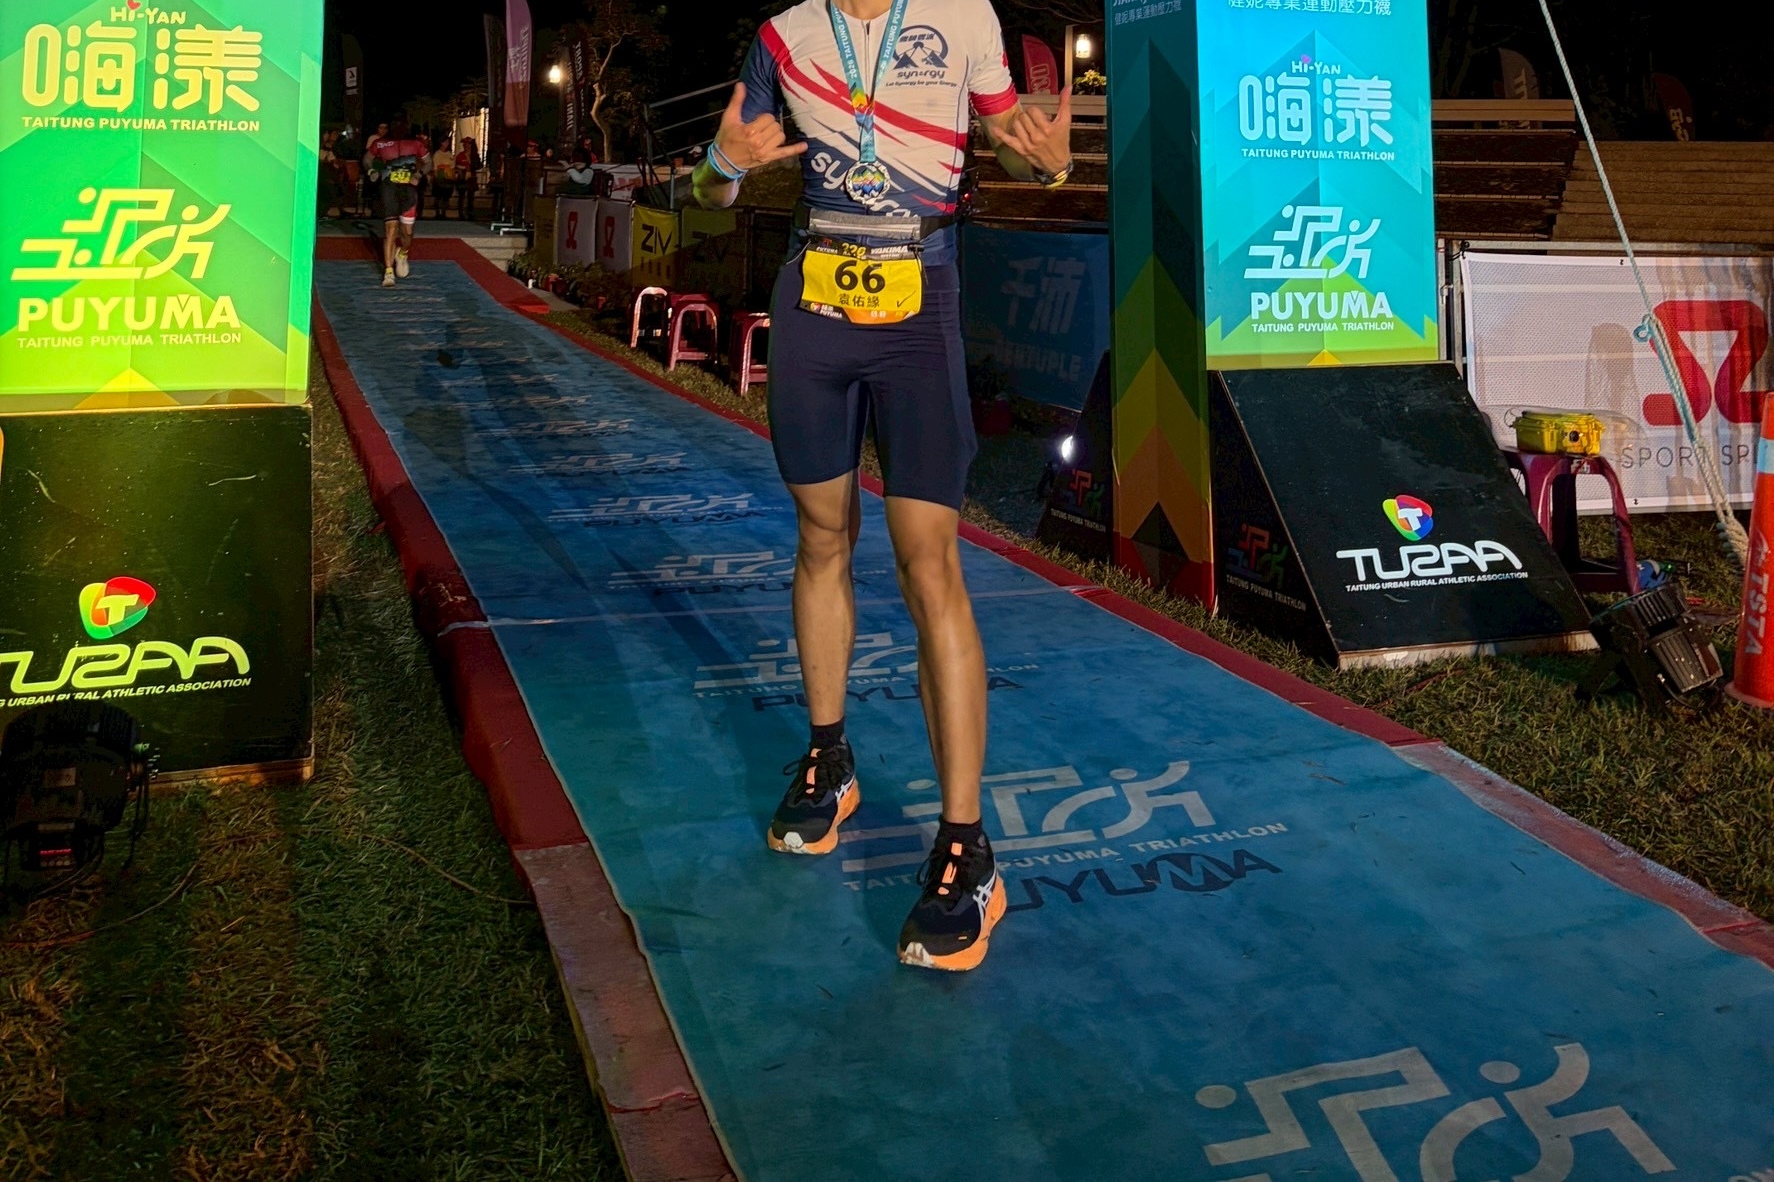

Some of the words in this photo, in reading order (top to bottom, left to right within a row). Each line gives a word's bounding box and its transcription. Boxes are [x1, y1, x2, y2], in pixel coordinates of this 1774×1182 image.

[22, 20, 263, 115] 嗨漾
[22, 116, 95, 130] TAITUNG
[99, 117, 167, 131] PUYUMA
[170, 119, 260, 132] TRIATHLON
[1239, 72, 1394, 146] 嗨漾
[1241, 148, 1289, 158] TAITUNG
[1290, 149, 1335, 159] PUYUMA
[1337, 150, 1395, 161] TRIATHLON
[835, 259, 886, 294] 66
[18, 294, 242, 332] PUYUMA
[1251, 290, 1394, 320] PUYUMA
[18, 336, 84, 349] TAITUNG
[91, 334, 154, 347] PUYUMA
[160, 332, 242, 345] TRIATHLON
[1252, 323, 1294, 333] TAITUNG
[1297, 322, 1338, 332] PUYUMA
[1342, 321, 1394, 331] TRIATHLON
[1621, 445, 1707, 469] SPOR
[1345, 583, 1381, 593] TAITUNG
[1381, 581, 1410, 590] URBAN
[1410, 579, 1437, 588] RURAL
[1438, 575, 1476, 585] ATHLETIC
[1476, 572, 1529, 582] ASSOCIATION
[7, 693, 58, 707] URBAN
[101, 684, 165, 700] ATHLETIC
[165, 677, 252, 694] ASSOCIATION
[1127, 822, 1288, 855] TRIATHLON
[1004, 849, 1285, 915] UYUMA
